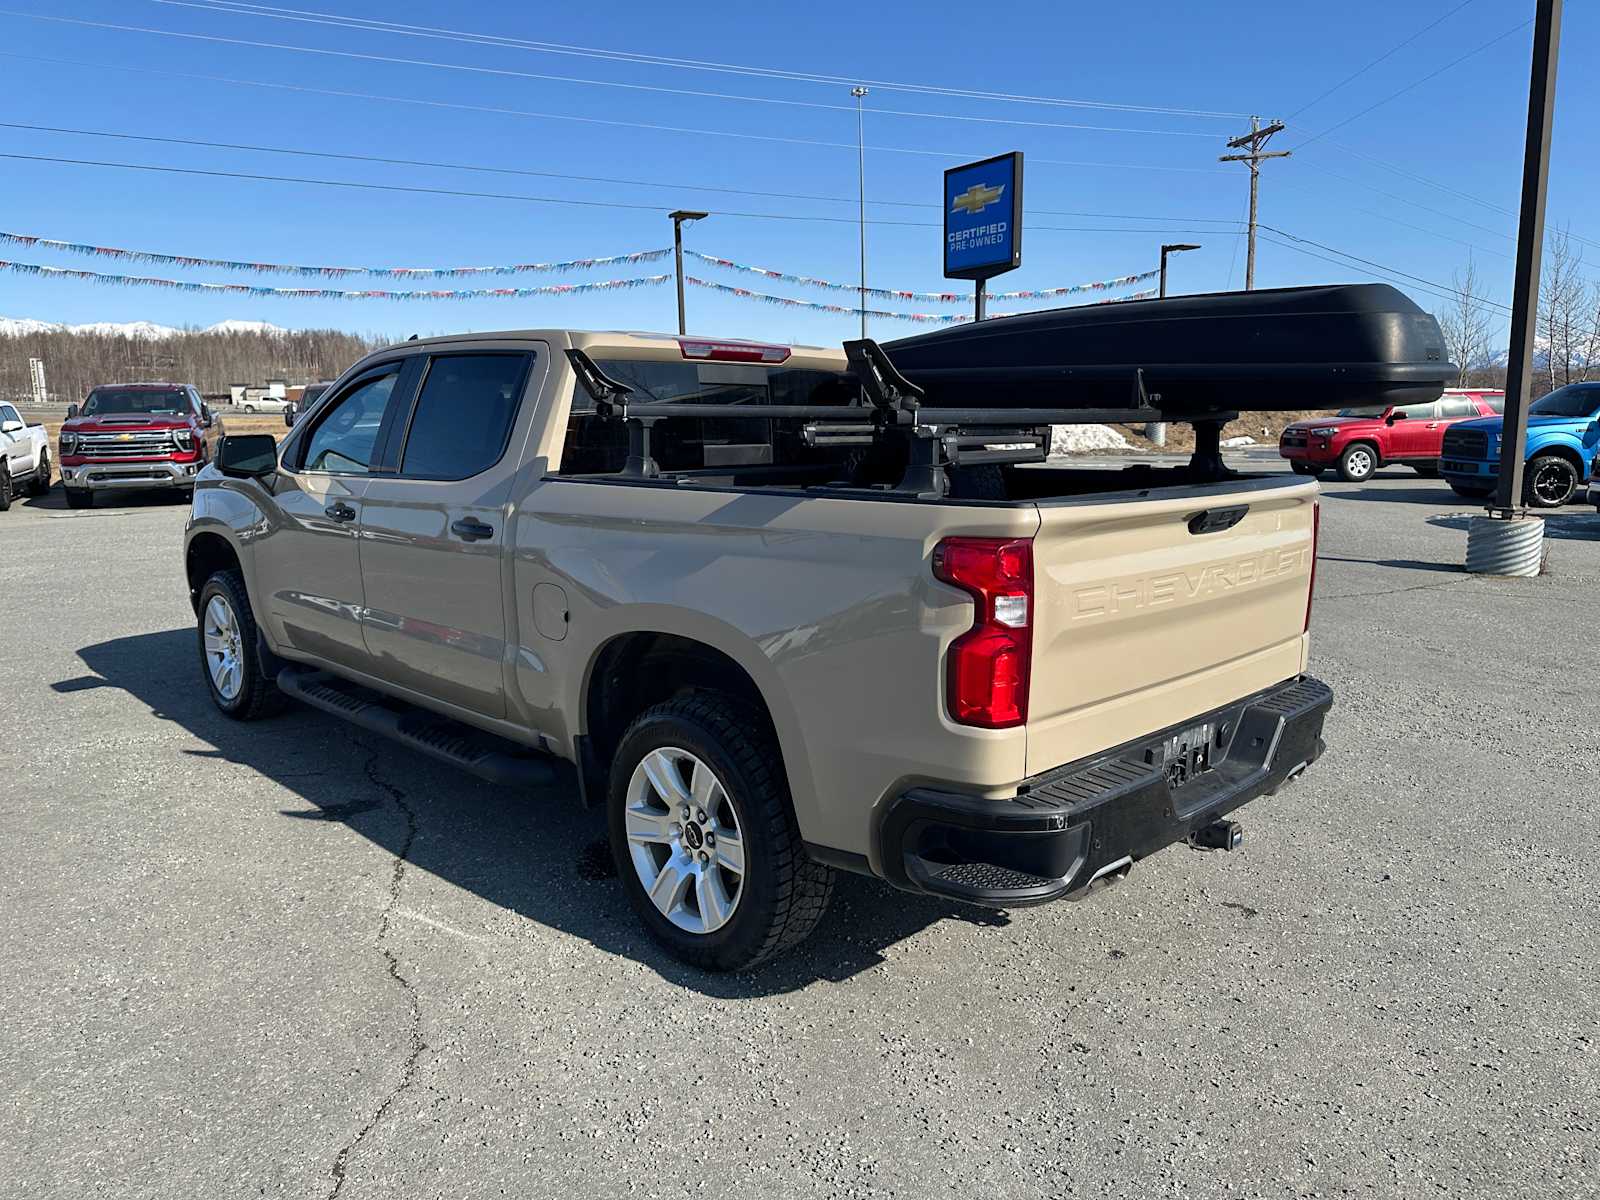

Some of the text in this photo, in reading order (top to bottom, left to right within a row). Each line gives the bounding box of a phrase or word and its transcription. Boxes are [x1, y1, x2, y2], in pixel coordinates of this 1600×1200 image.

[947, 222, 1007, 242] CERTIFIED
[950, 233, 1004, 252] PRE-OWNED
[1071, 547, 1310, 620] CHEVROLET
